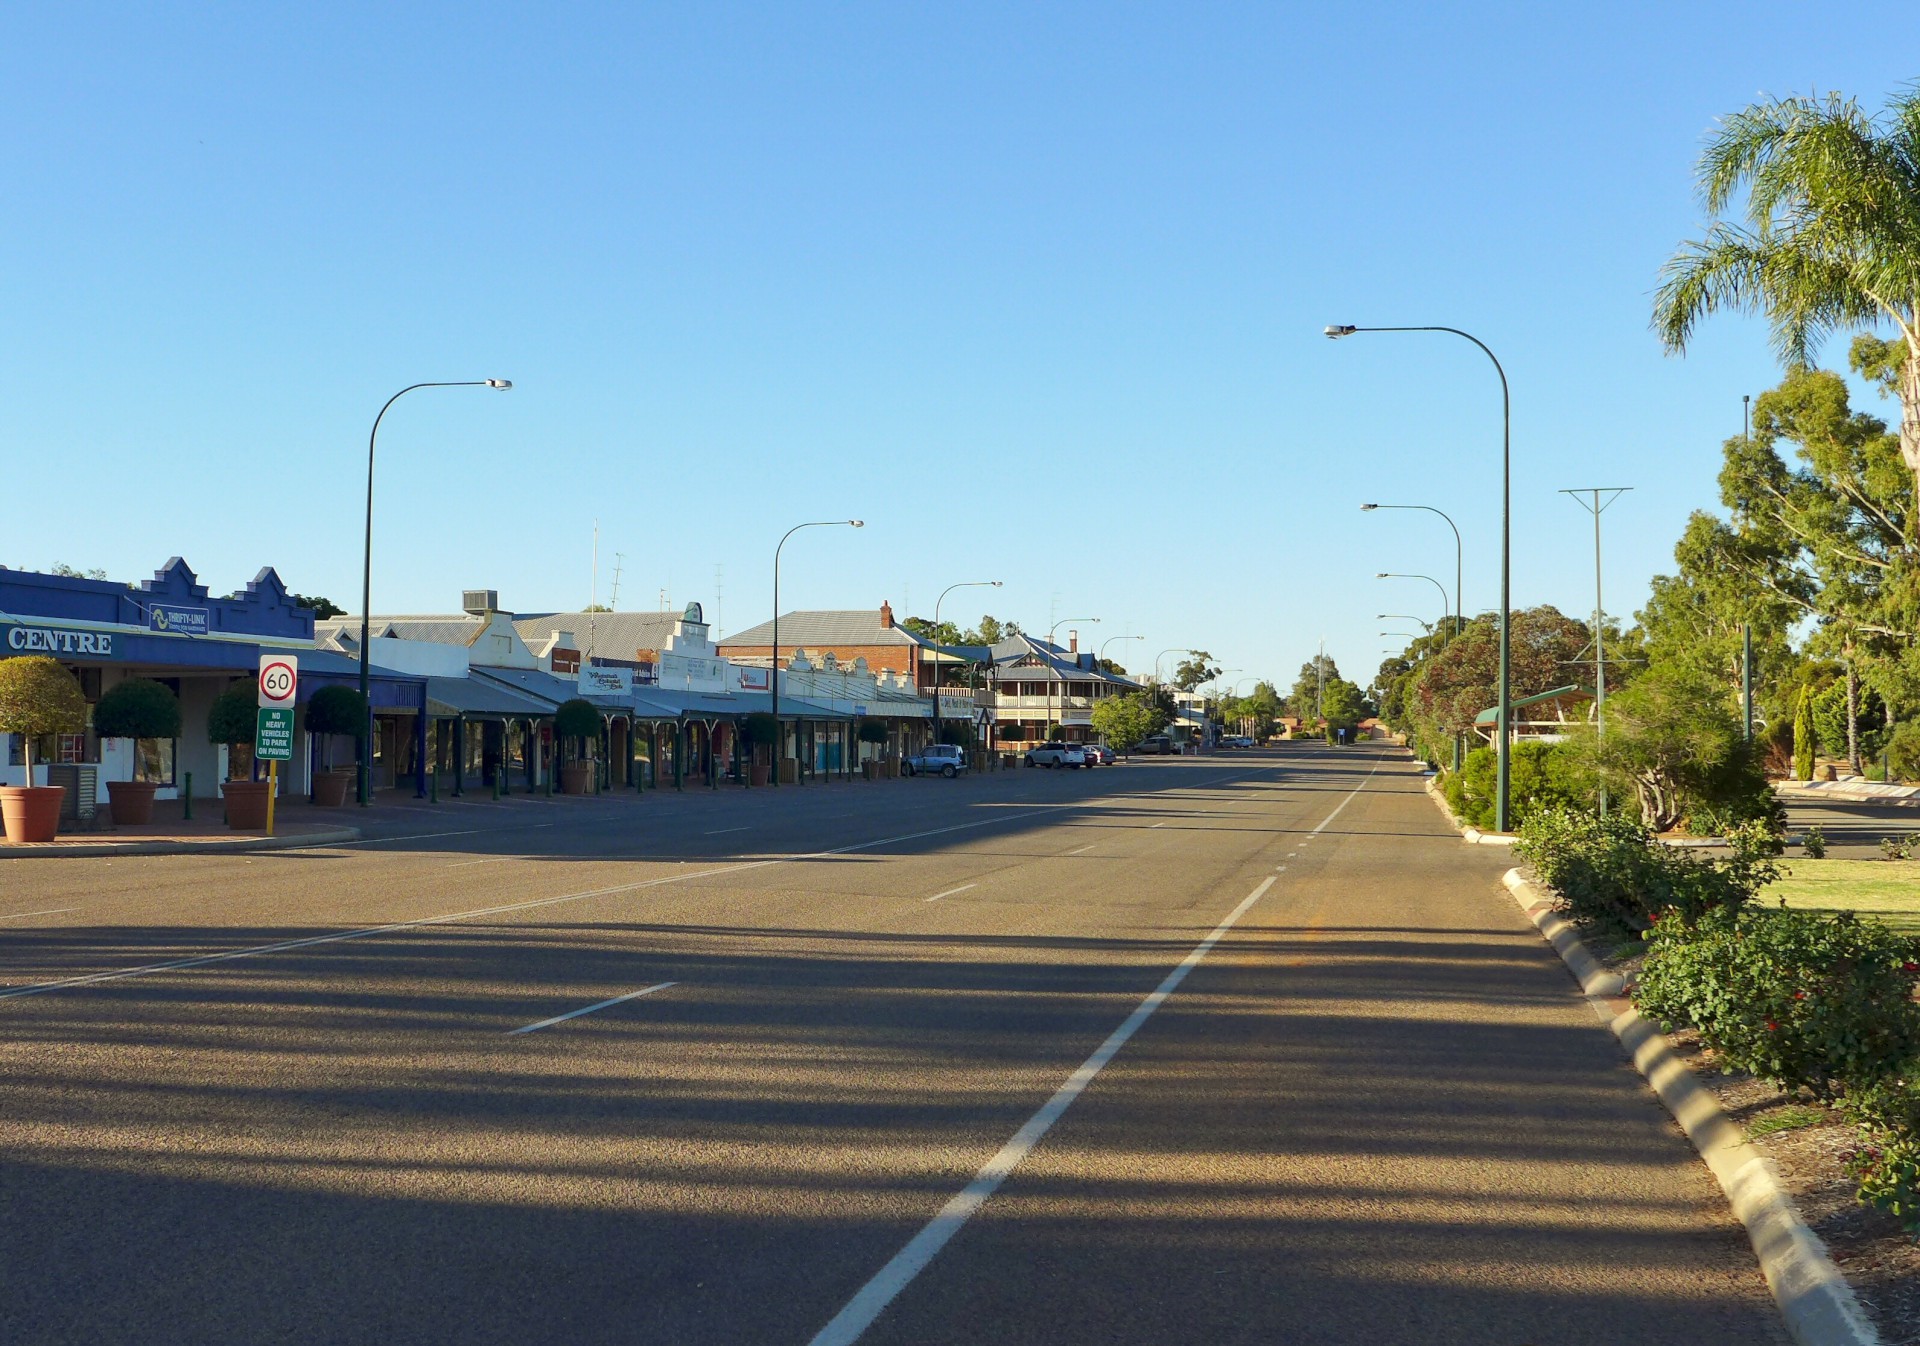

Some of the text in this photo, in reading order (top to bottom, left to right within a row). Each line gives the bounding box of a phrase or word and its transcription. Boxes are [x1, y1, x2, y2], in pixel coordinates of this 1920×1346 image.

[167, 612, 205, 625] THRIFTY-LINK
[8, 627, 112, 655] CENTRE
[266, 673, 289, 690] 60
[265, 720, 286, 729] HEAVY
[261, 729, 290, 738] VEHICLES
[262, 738, 287, 747] TO PARK
[258, 747, 290, 756] ON PAVING
